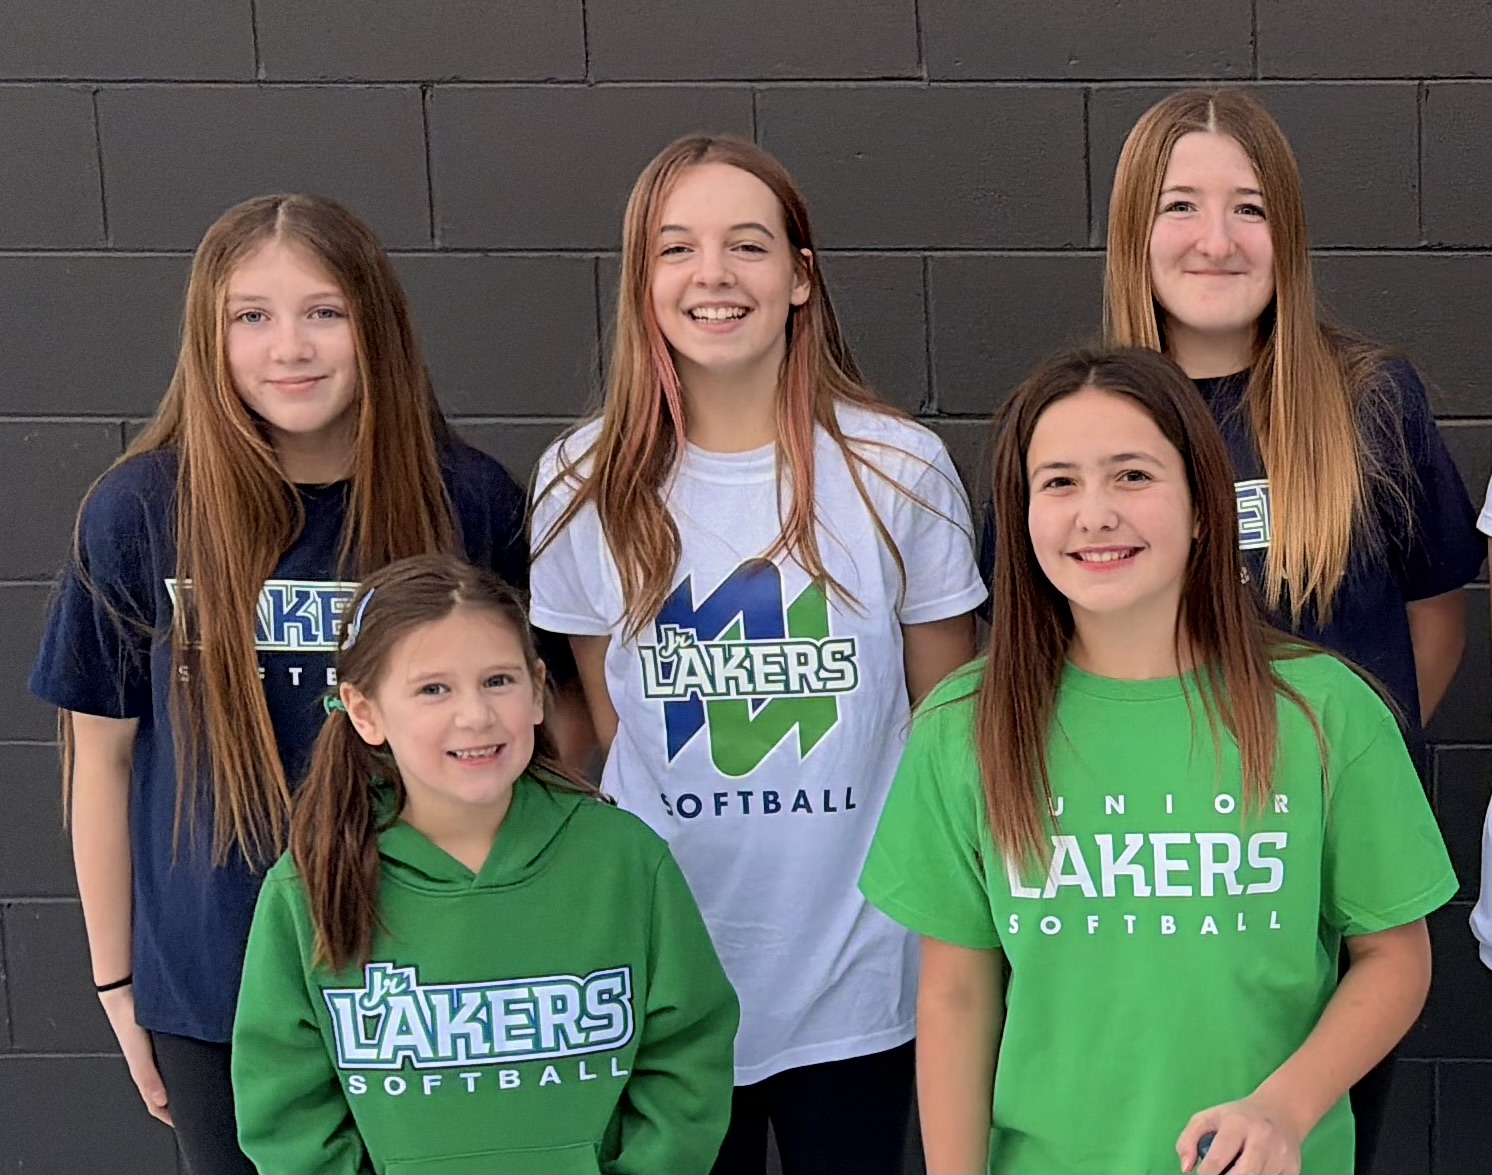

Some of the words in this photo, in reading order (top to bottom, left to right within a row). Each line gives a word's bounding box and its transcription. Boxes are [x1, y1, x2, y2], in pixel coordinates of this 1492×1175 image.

[658, 627, 695, 657] Jr
[639, 640, 856, 696] LAKERS
[1047, 794, 1289, 816] UNIOR
[1008, 911, 1281, 935] SOFTBALL
[360, 969, 409, 1006] Jr
[330, 974, 629, 1062] LAKERS
[348, 1057, 629, 1095] SOFTBALL
